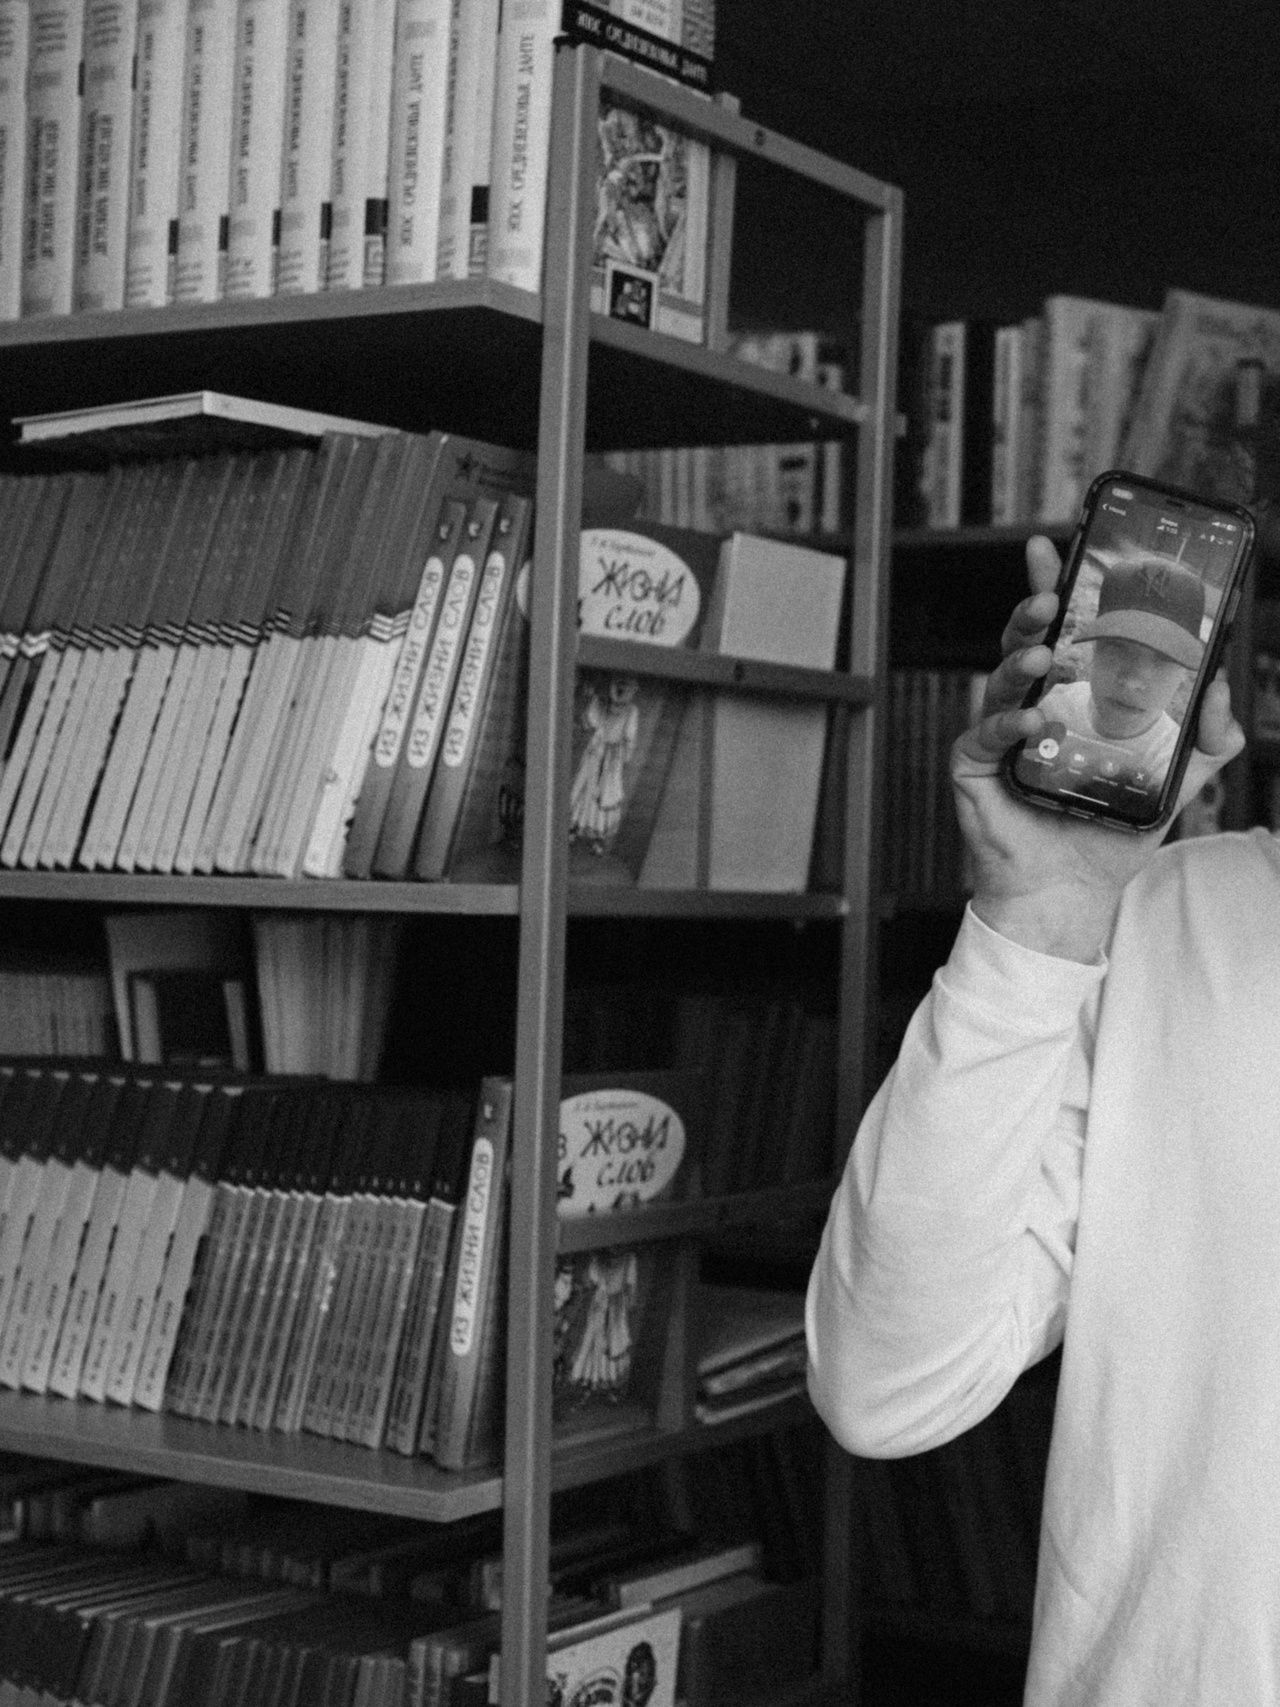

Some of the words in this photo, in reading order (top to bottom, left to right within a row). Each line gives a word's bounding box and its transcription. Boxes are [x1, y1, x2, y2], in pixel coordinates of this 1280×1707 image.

[378, 728, 397, 757] ИЗ
[389, 640, 418, 719] ЖИЗНИ
[414, 571, 438, 630] СЛОВ
[410, 728, 429, 757] ИЗ
[420, 638, 450, 720] ЖИЗНИ
[445, 568, 469, 629] СЛОВ
[448, 728, 464, 756] ИЗ
[456, 637, 482, 718] ЖИЗНИ
[477, 565, 500, 627] СЛОВ
[470, 1153, 490, 1213] СЛОВ
[454, 1317, 469, 1345] ИЗ
[458, 1225, 480, 1306] ЖИЗНИ
